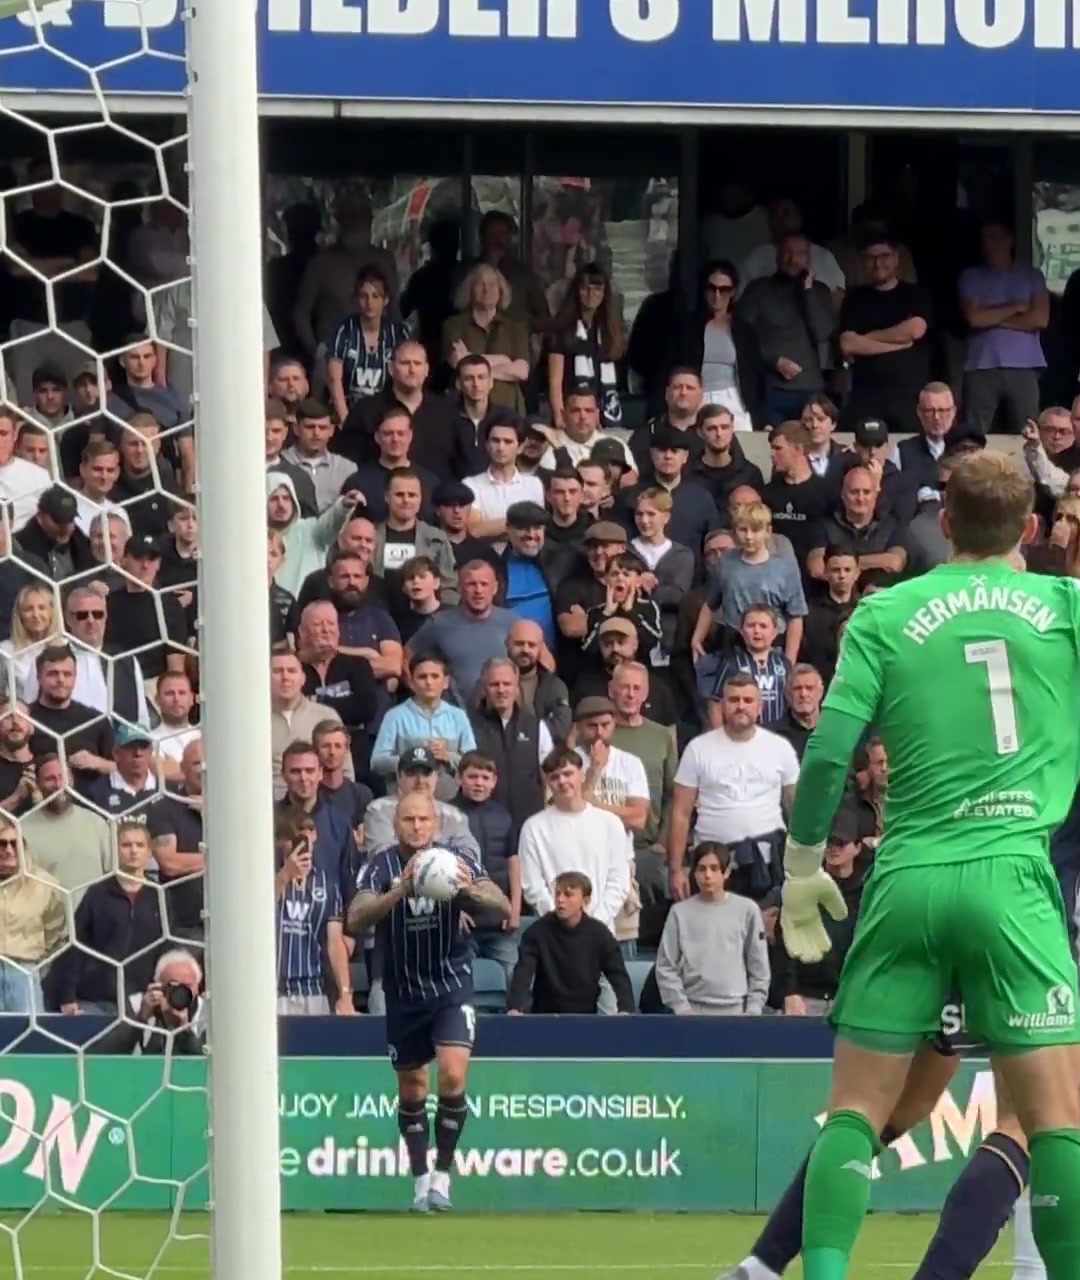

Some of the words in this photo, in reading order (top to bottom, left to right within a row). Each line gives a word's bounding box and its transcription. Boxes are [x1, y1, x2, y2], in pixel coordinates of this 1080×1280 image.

[903, 586, 1057, 645] HERMANSEN
[964, 639, 1019, 755] 1
[286, 900, 309, 920] W
[1008, 1011, 1076, 1028] Williams
[280, 1093, 338, 1118] JOY
[346, 1093, 481, 1118] JAMSN
[489, 1094, 687, 1119] RESPONSIBLY.
[280, 1147, 301, 1176] e
